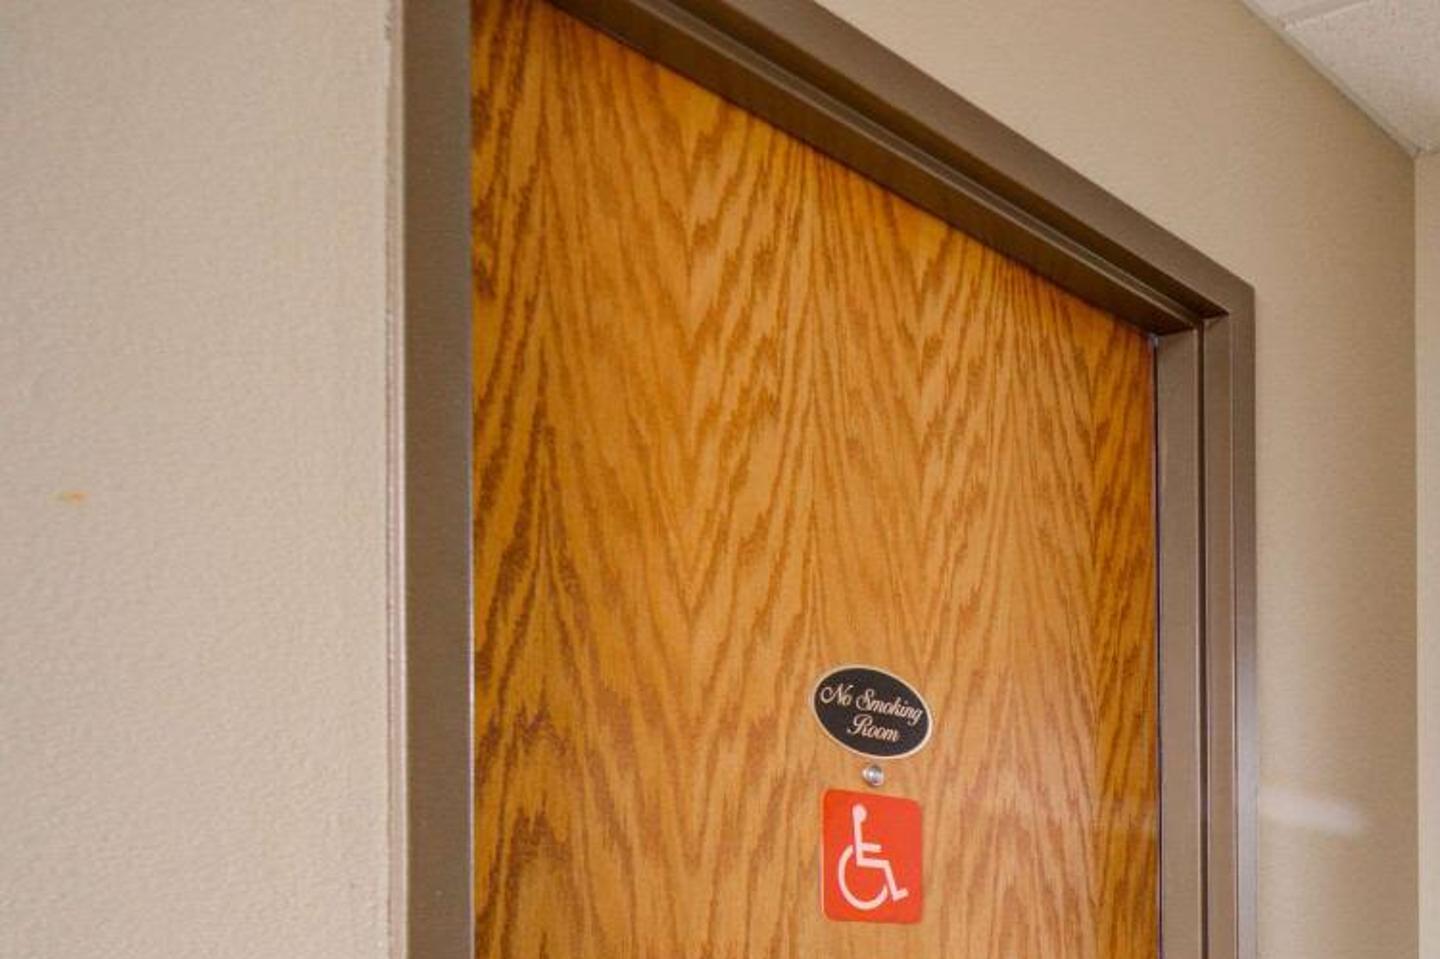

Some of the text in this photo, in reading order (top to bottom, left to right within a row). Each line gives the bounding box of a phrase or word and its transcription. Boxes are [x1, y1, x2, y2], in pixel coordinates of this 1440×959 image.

[820, 683, 924, 727] No Smoking
[846, 714, 899, 742] Room
